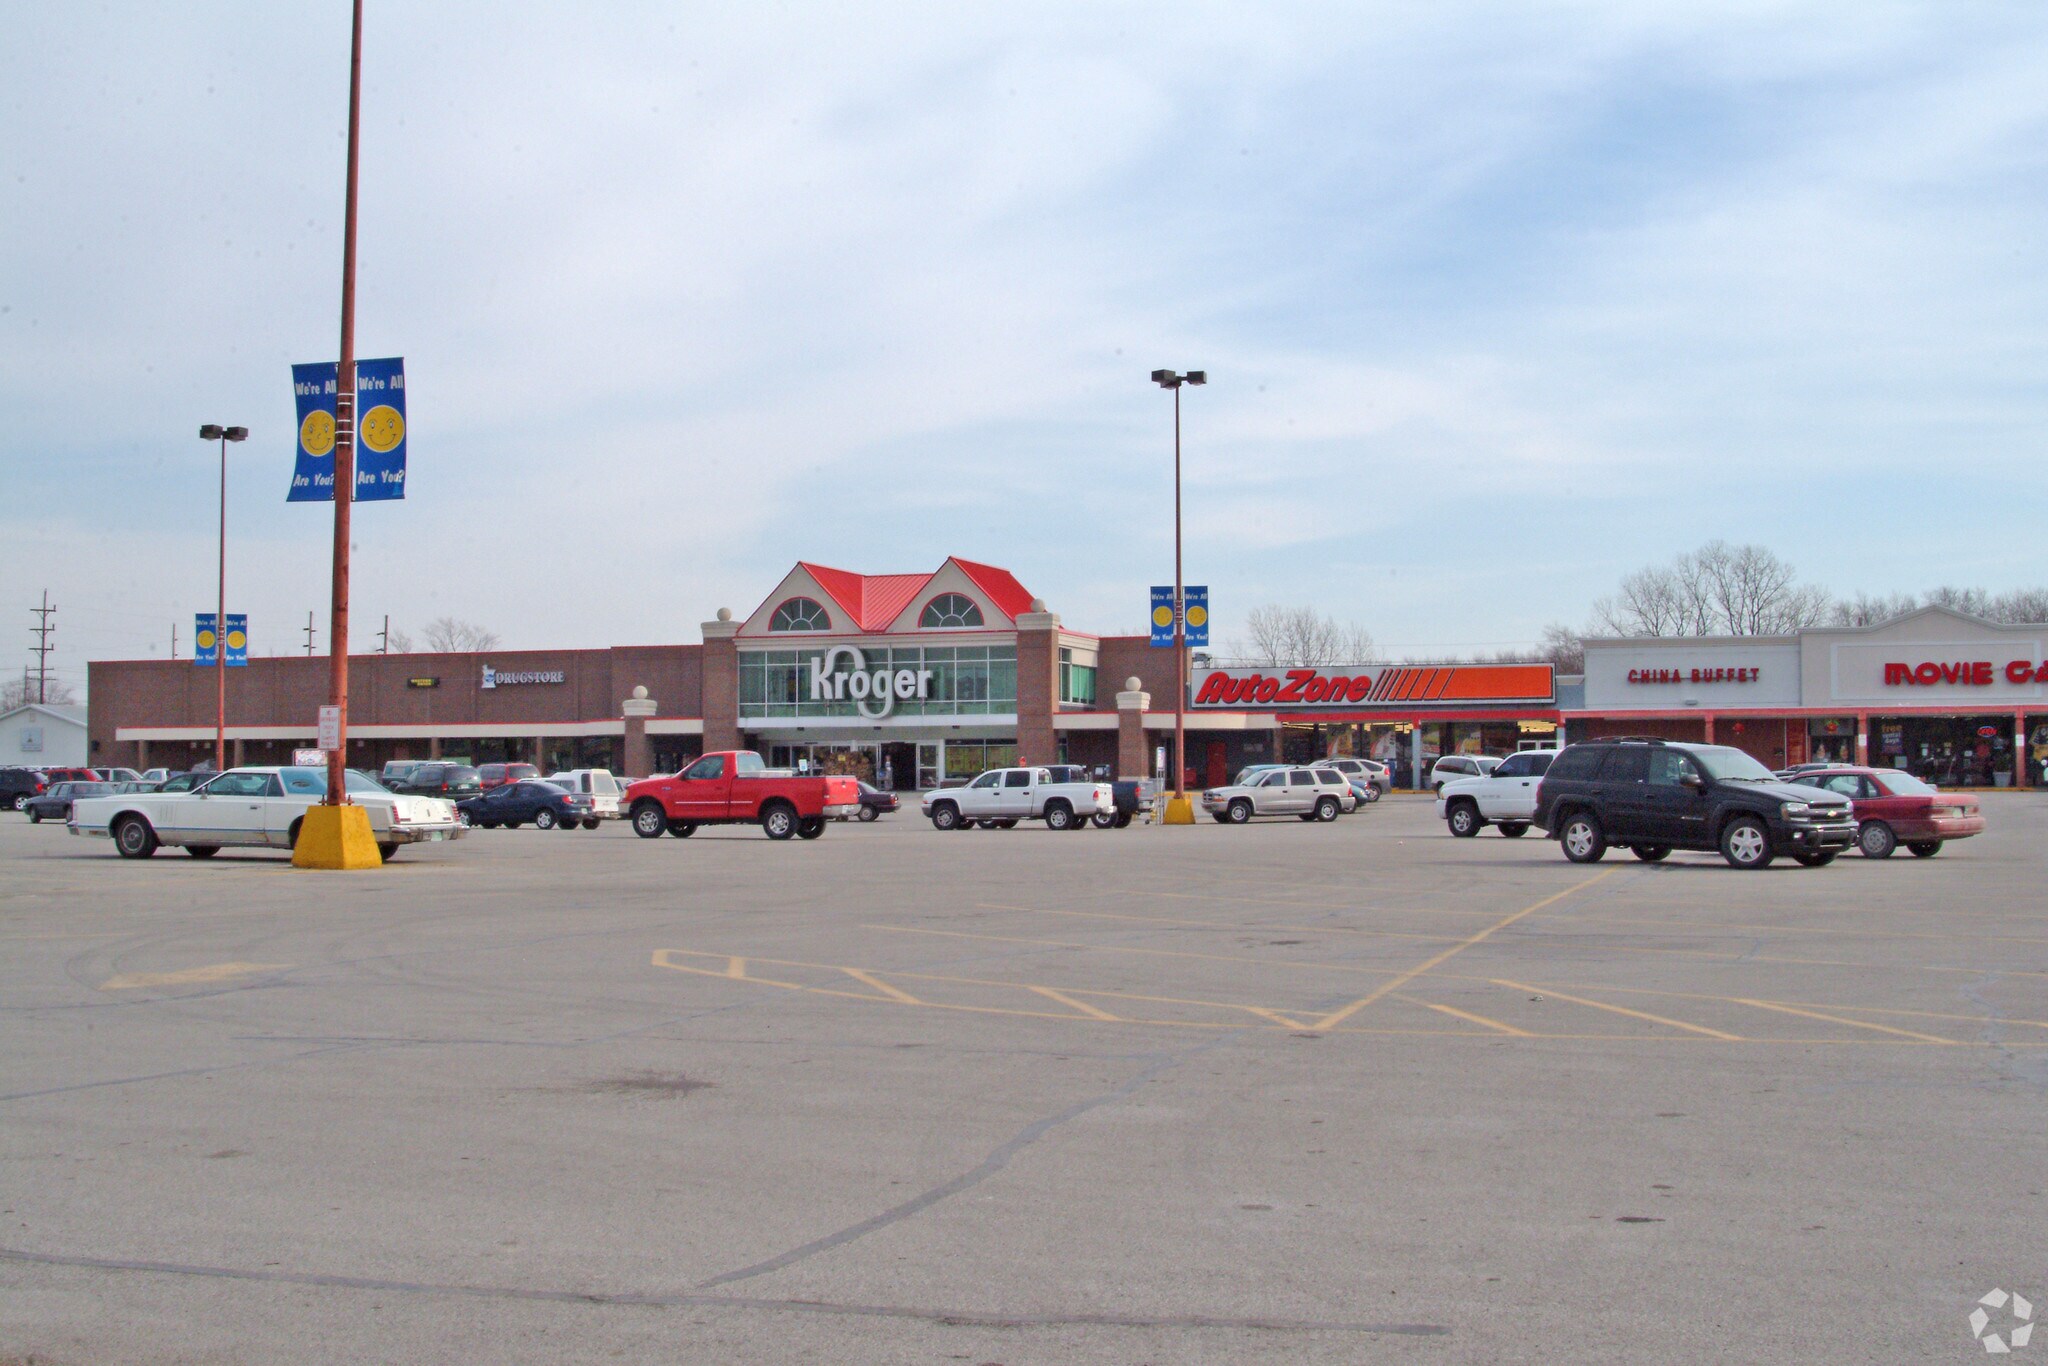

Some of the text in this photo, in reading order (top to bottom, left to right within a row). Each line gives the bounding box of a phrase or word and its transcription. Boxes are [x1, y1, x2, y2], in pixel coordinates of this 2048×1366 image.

[296, 380, 336, 396] We're All
[359, 374, 404, 390] We're All
[293, 472, 334, 487] Are You?
[358, 470, 404, 485] Are You?
[496, 671, 564, 684] DRUGSTORE
[810, 644, 933, 719] Kroger
[1628, 668, 1760, 684] CHINA BUFFET
[1884, 662, 1994, 685] MOVIE
[1194, 670, 1372, 704] AutoZone
